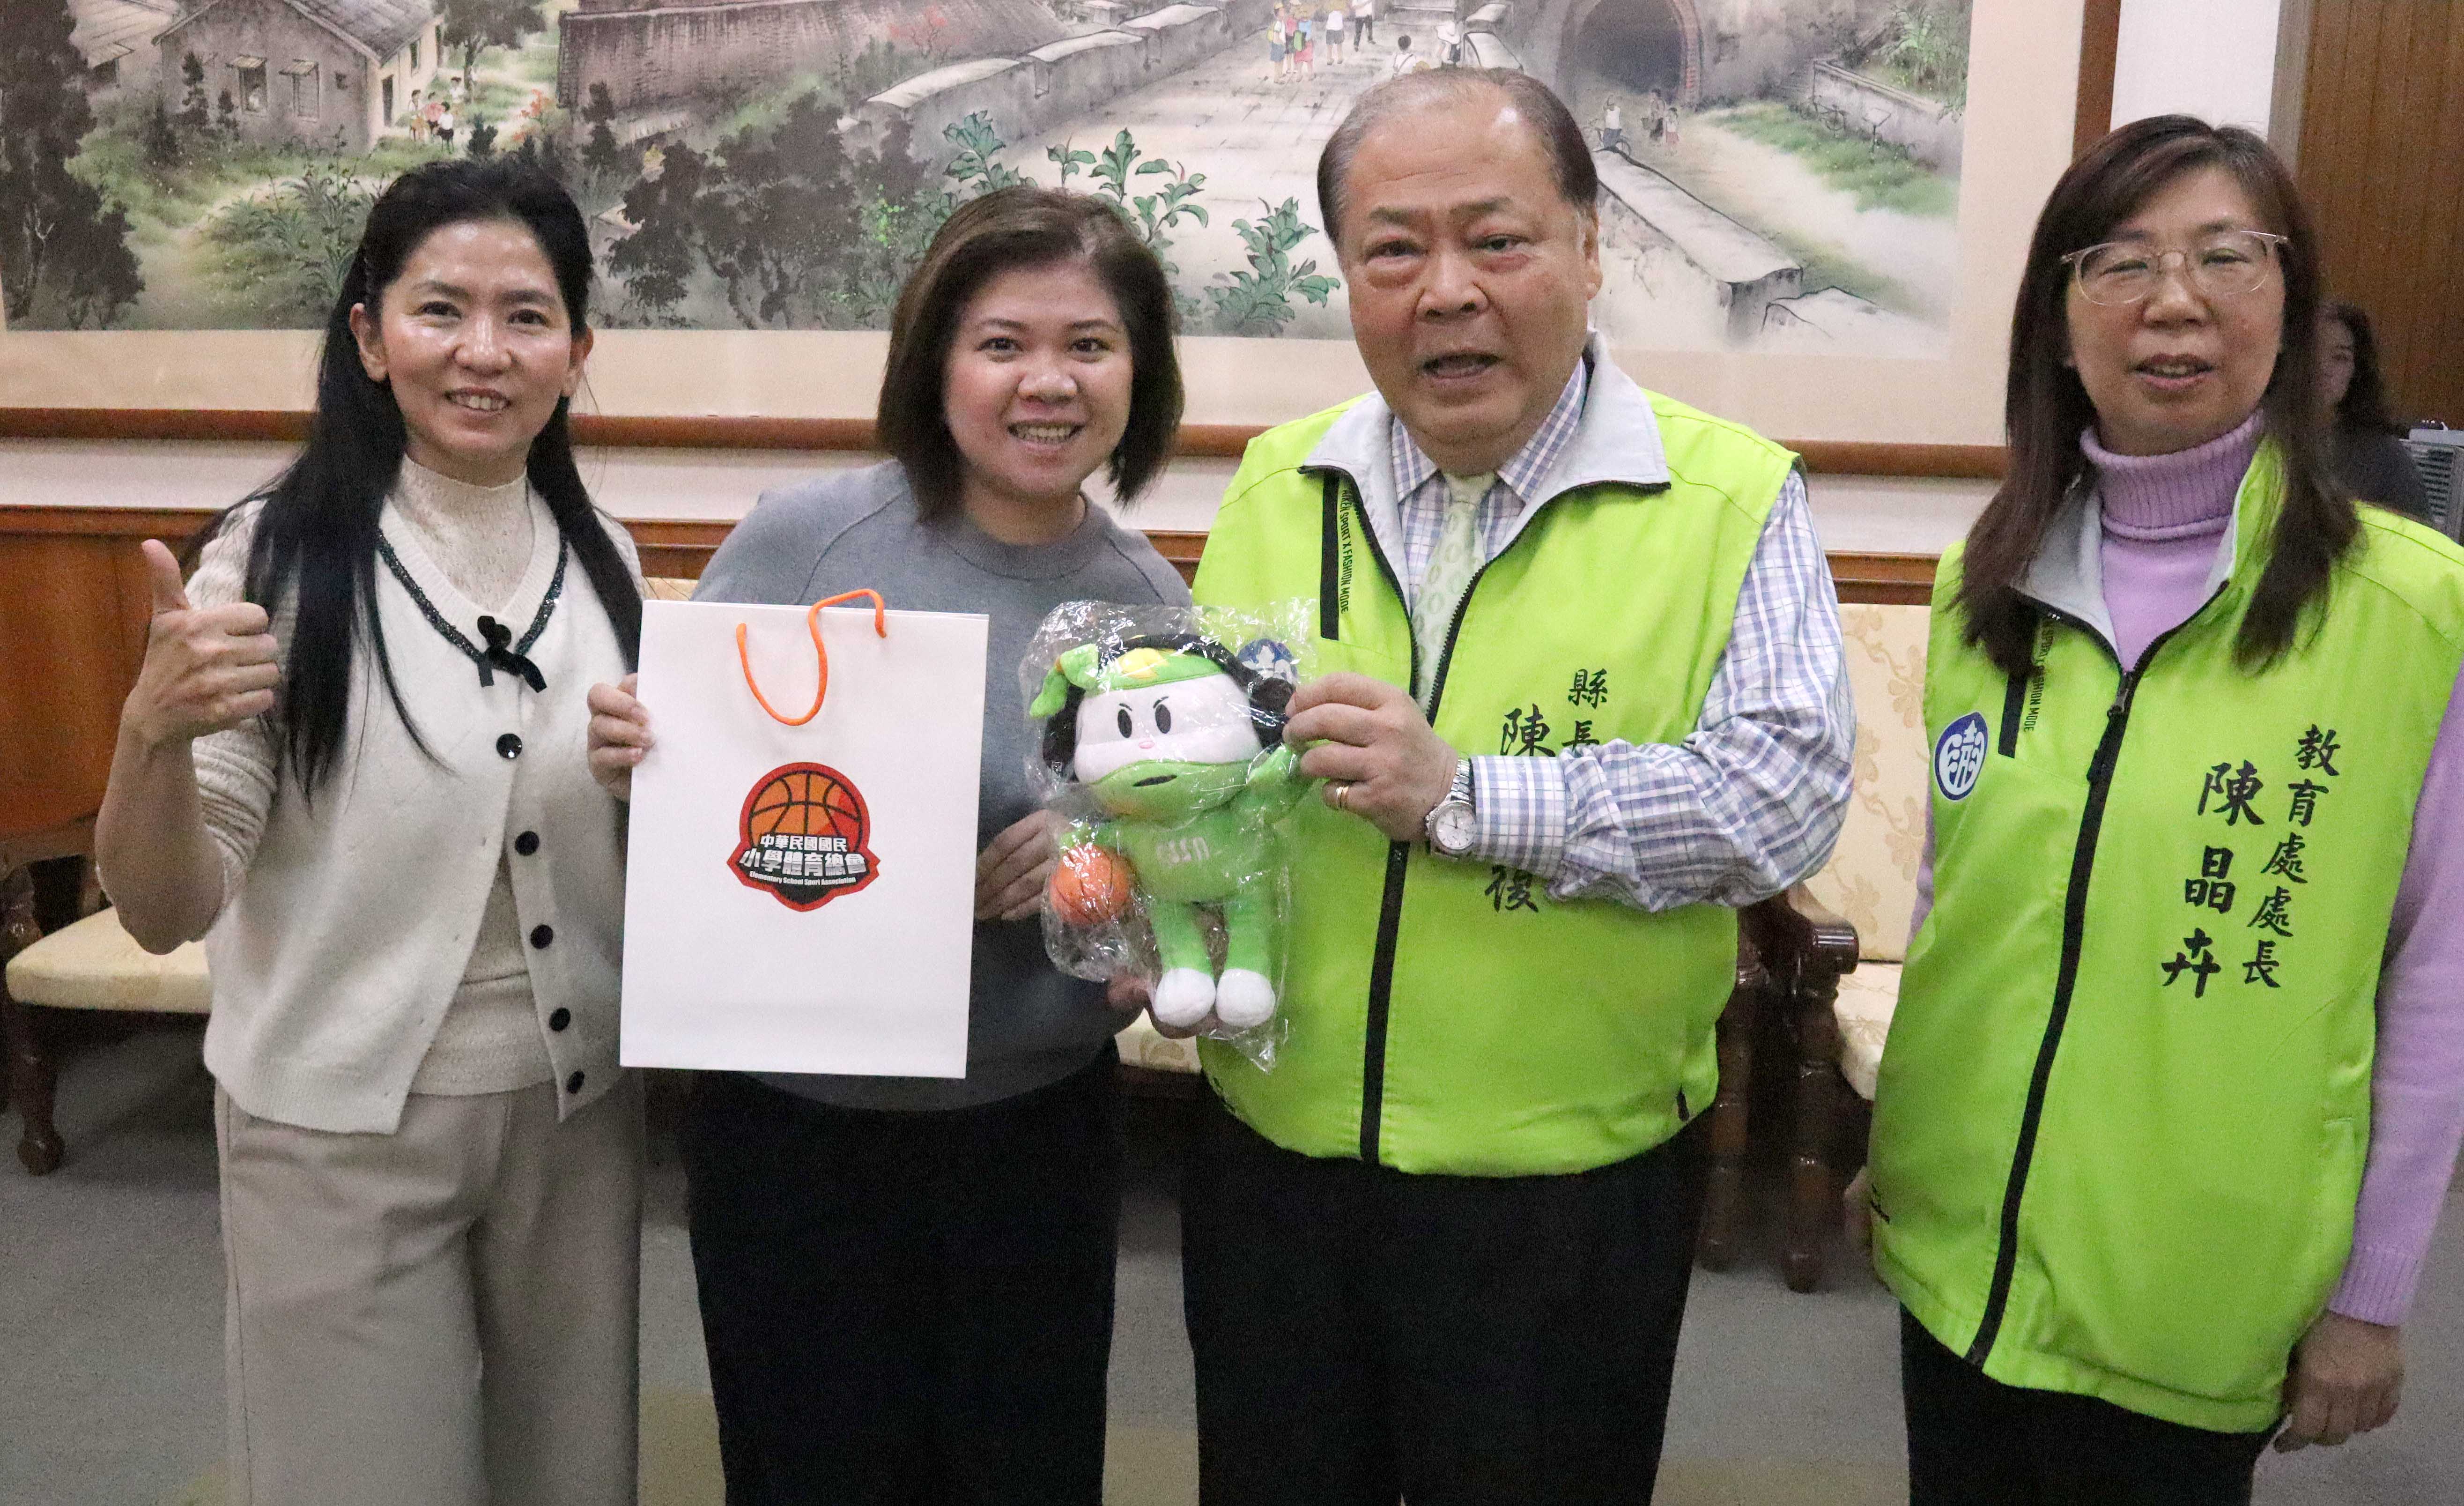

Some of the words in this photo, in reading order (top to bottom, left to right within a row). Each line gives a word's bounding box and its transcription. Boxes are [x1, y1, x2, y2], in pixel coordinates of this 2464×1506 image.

[1340, 512, 1351, 541] SPORT
[1341, 549, 1353, 586] FASHION
[1339, 587, 1350, 614] MODE
[1561, 668, 1608, 753] 縣長
[2023, 707, 2040, 733] MODE
[760, 834, 847, 852] 中華民國國民
[2242, 724, 2341, 988] 教育處處長
[739, 848, 866, 876] 小學體育總會
[749, 871, 783, 884] Elementary
[821, 876, 856, 885] Association
[2161, 759, 2265, 999] 陳晶卉
